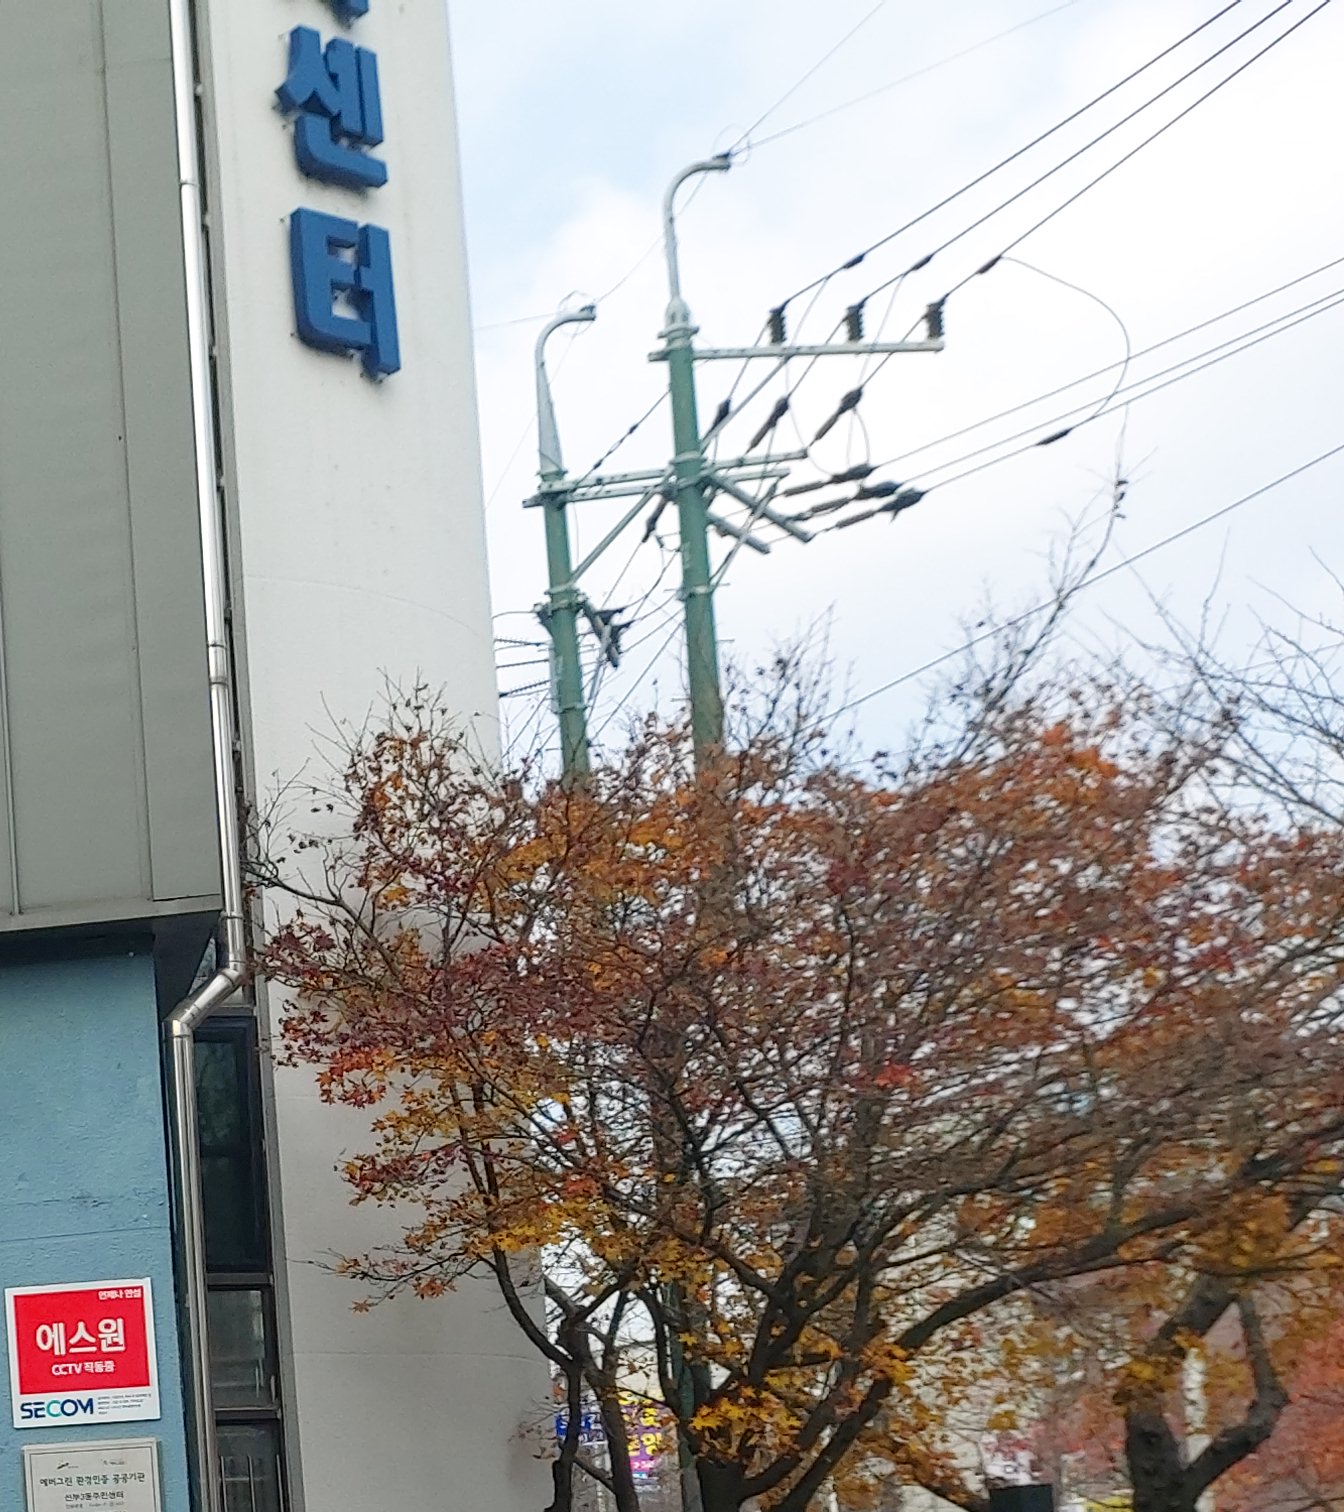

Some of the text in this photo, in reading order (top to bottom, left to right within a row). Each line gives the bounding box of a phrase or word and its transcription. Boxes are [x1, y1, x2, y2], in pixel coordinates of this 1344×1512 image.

[274, 0, 401, 383] 센터
[35, 1317, 126, 1356] 에스원
[51, 1362, 82, 1376] CCTV
[20, 1398, 94, 1419] SECOM
[112, 1472, 145, 1485] 공공기관
